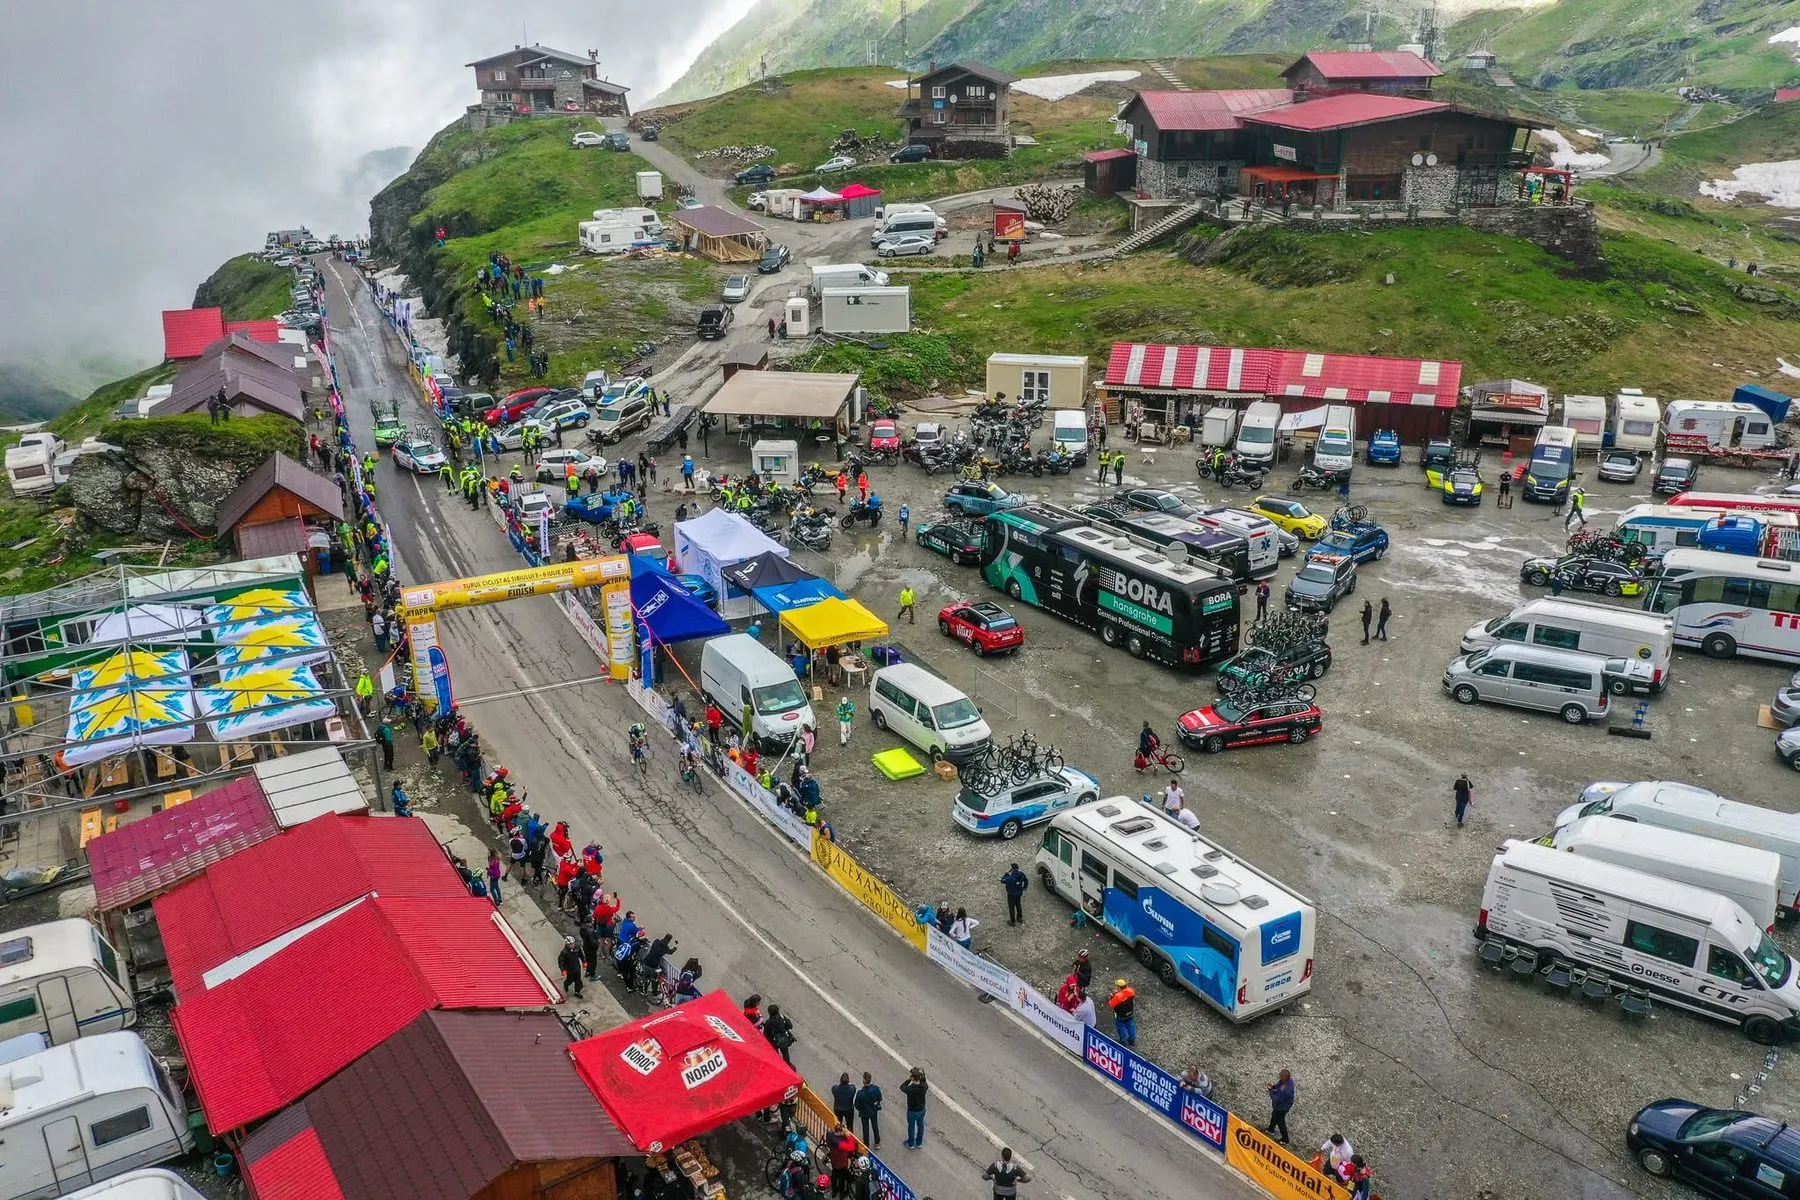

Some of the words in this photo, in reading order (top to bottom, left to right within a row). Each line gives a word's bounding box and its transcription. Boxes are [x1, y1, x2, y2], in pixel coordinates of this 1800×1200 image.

[463, 582, 481, 591] TURUL
[481, 578, 503, 587] CICLIST
[507, 587, 535, 598] FINISH
[1114, 572, 1174, 616] BORA
[1208, 592, 1232, 605] BORA
[1097, 608, 1118, 623] German
[1118, 617, 1151, 638] Professional
[1113, 595, 1157, 625] hansgrohe
[833, 853, 926, 936] ALEXANDRION
[863, 893, 893, 920] GROUP
[1645, 969, 1680, 985] oesse
[1698, 985, 1749, 1003] CTF
[1033, 1003, 1080, 1042] Promenada
[624, 1046, 655, 1072] NOROC
[1089, 1035, 1122, 1065] LIQUI
[1089, 1047, 1123, 1077] MOLY
[685, 1054, 723, 1084] NOROC
[1129, 1058, 1158, 1083] MOTOR
[1159, 1076, 1177, 1095] OILS
[1131, 1071, 1173, 1103] ADDITIVES
[1133, 1081, 1149, 1098] CAR
[1150, 1091, 1170, 1111] CARE
[1183, 1108, 1222, 1142] MOLY
[1184, 1094, 1222, 1128] LIQUI
[1236, 1127, 1322, 1195] Continental
[1253, 1155, 1264, 1169] The
[1265, 1164, 1287, 1182] Future
[1287, 1180, 1294, 1188] in
